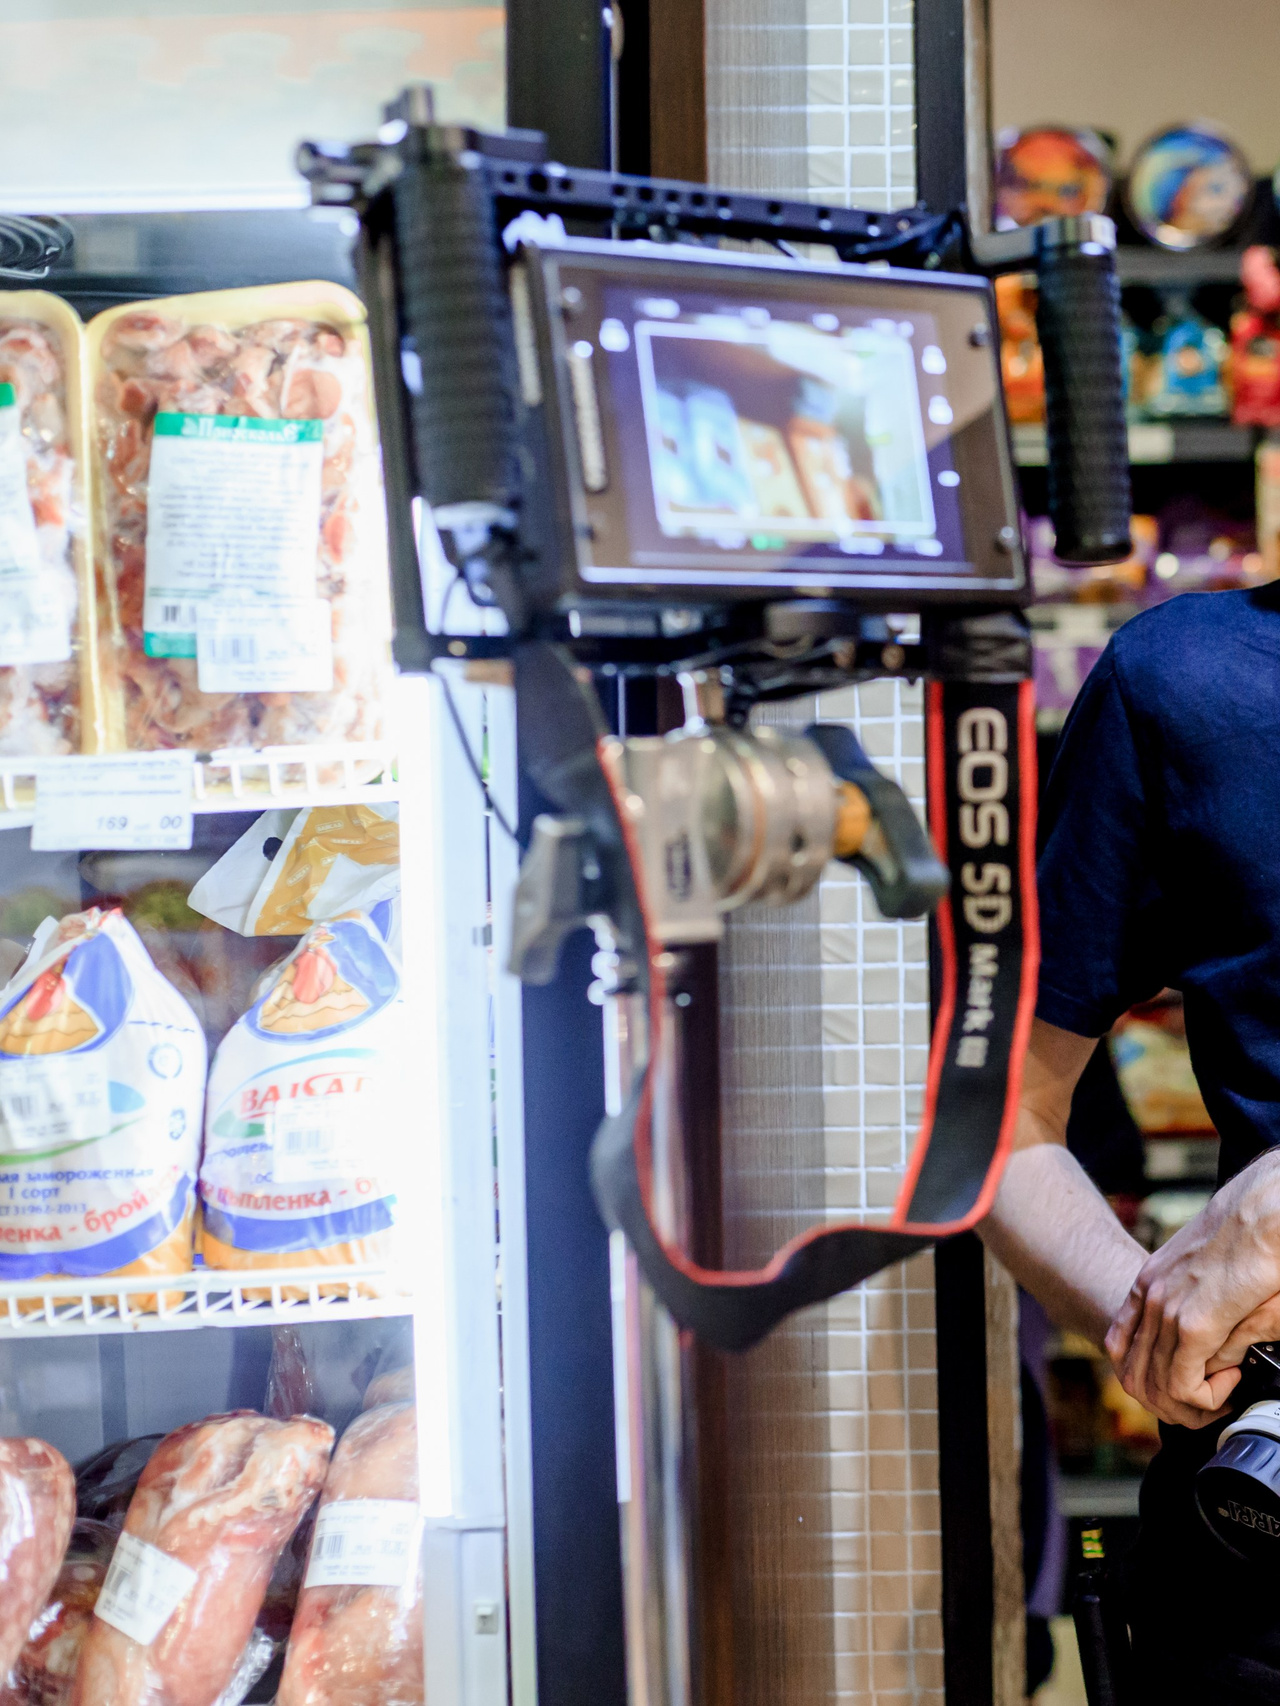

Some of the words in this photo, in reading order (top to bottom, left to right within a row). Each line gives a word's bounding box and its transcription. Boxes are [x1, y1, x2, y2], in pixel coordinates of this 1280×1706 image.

[957, 706, 1009, 849] EOS
[159, 816, 183, 830] 00
[961, 862, 1013, 935] 5D
[962, 943, 998, 1033] Mark
[21, 1187, 60, 1202] сорт
